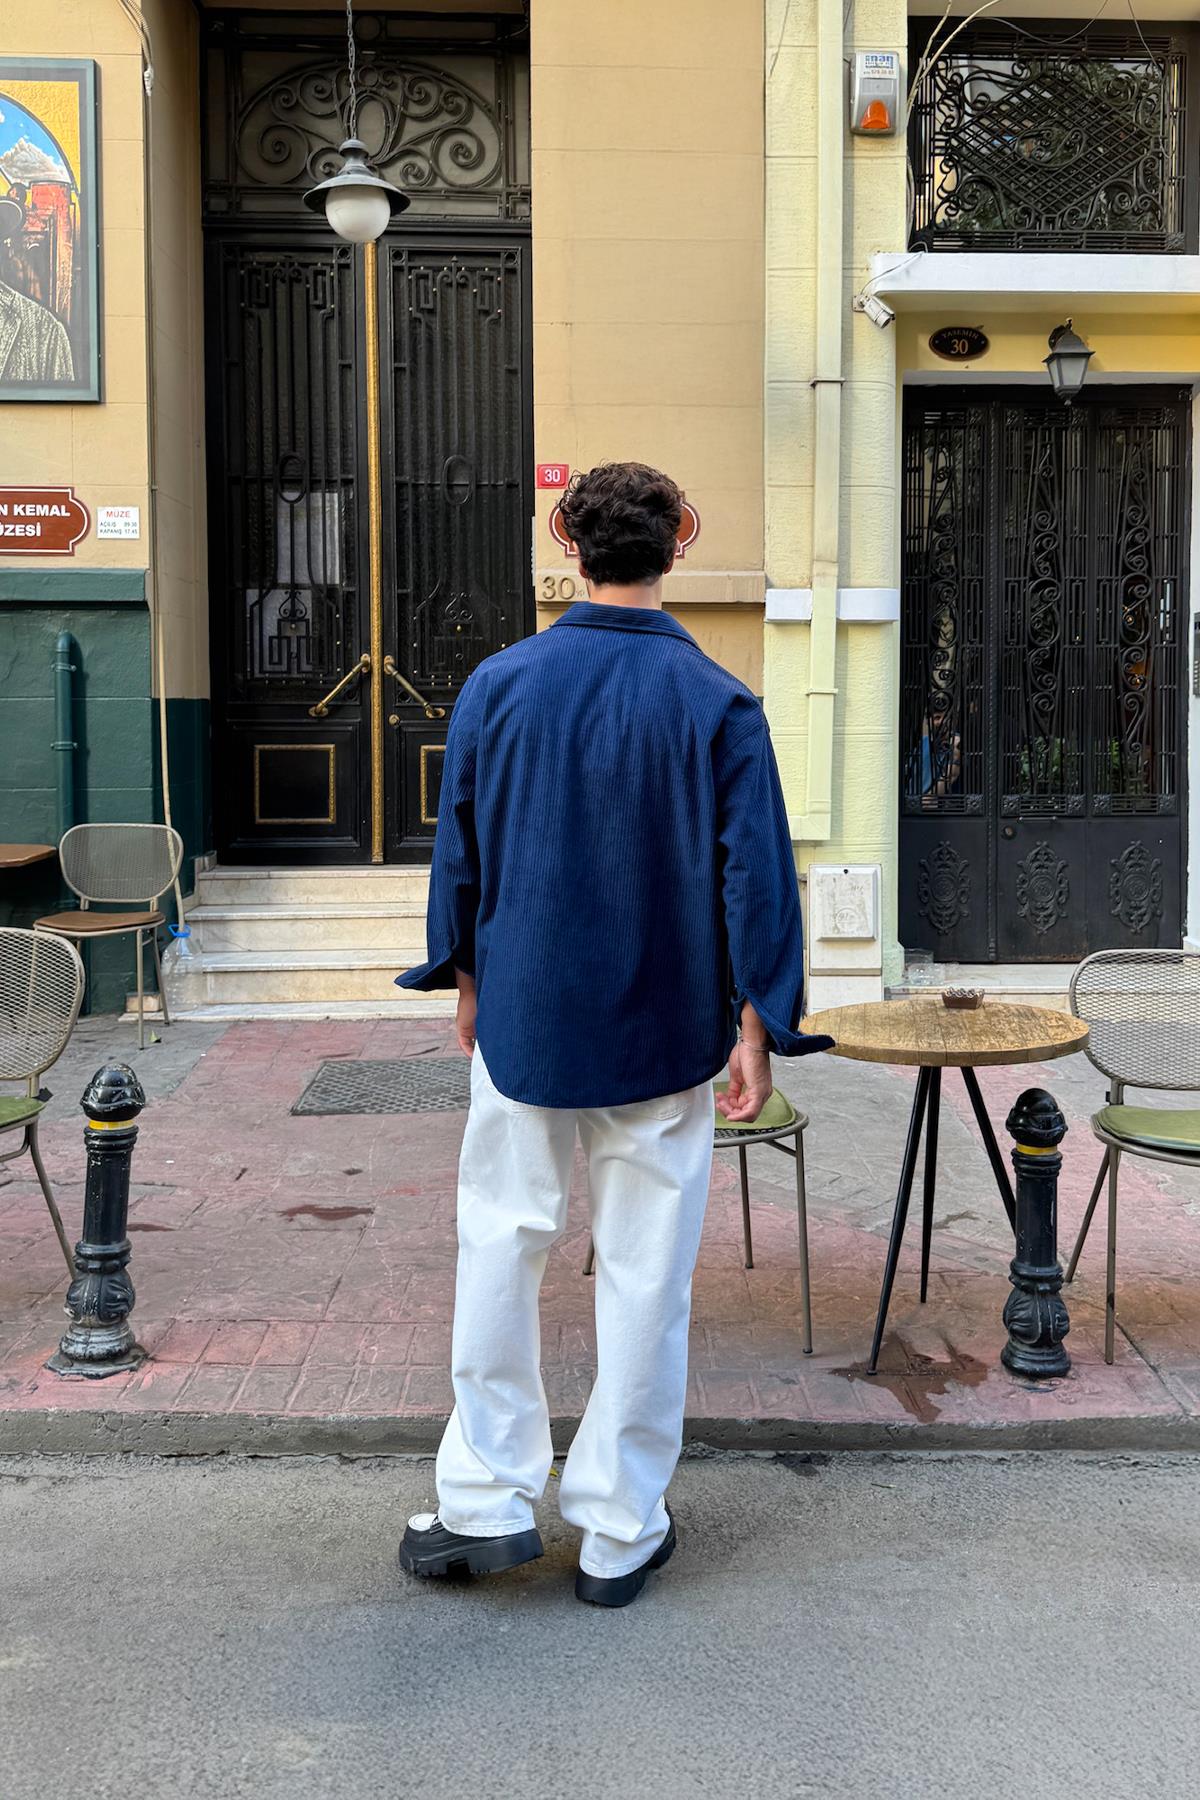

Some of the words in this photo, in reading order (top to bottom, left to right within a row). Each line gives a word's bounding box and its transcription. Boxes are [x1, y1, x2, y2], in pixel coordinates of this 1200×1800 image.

[950, 338, 969, 355] 30
[544, 469, 561, 482] 30
[13, 504, 71, 517] KEMAL
[542, 576, 576, 600] 30
